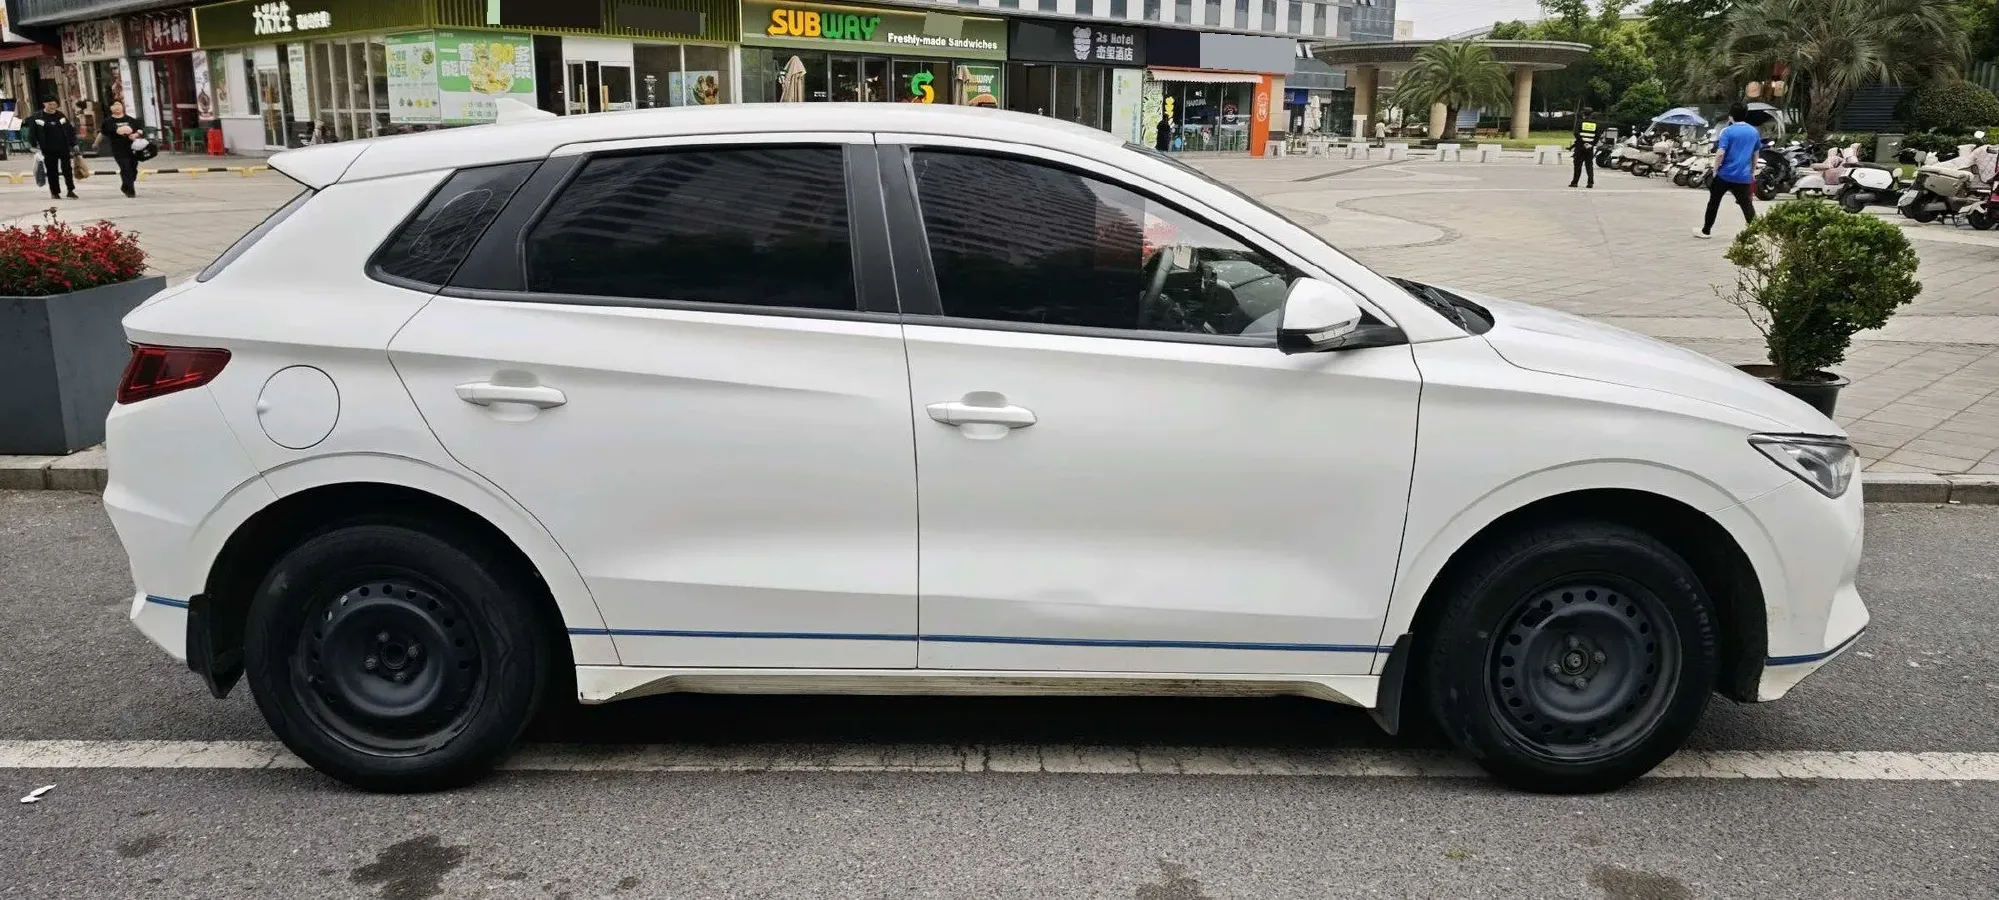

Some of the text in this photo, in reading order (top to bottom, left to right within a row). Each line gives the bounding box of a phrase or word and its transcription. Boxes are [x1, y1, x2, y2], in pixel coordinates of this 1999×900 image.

[767, 9, 881, 40] SUBWAY
[887, 32, 998, 50] Freshly-made Sandwiches
[1110, 33, 1134, 45] Hotel
